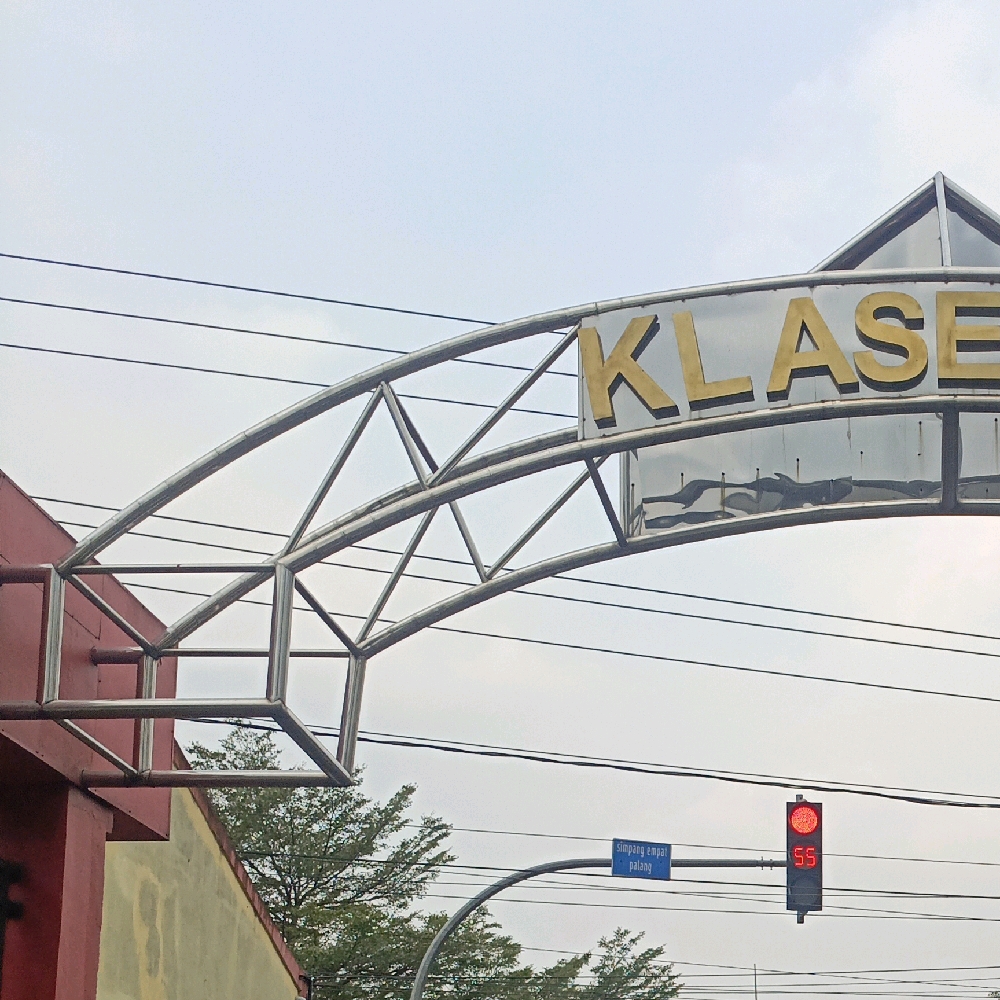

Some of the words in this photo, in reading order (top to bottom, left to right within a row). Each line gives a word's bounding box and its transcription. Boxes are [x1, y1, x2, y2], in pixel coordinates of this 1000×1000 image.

[616, 841, 645, 858] simpang
[647, 846, 668, 859] empat
[794, 847, 816, 867] 55
[629, 859, 653, 875] palang
